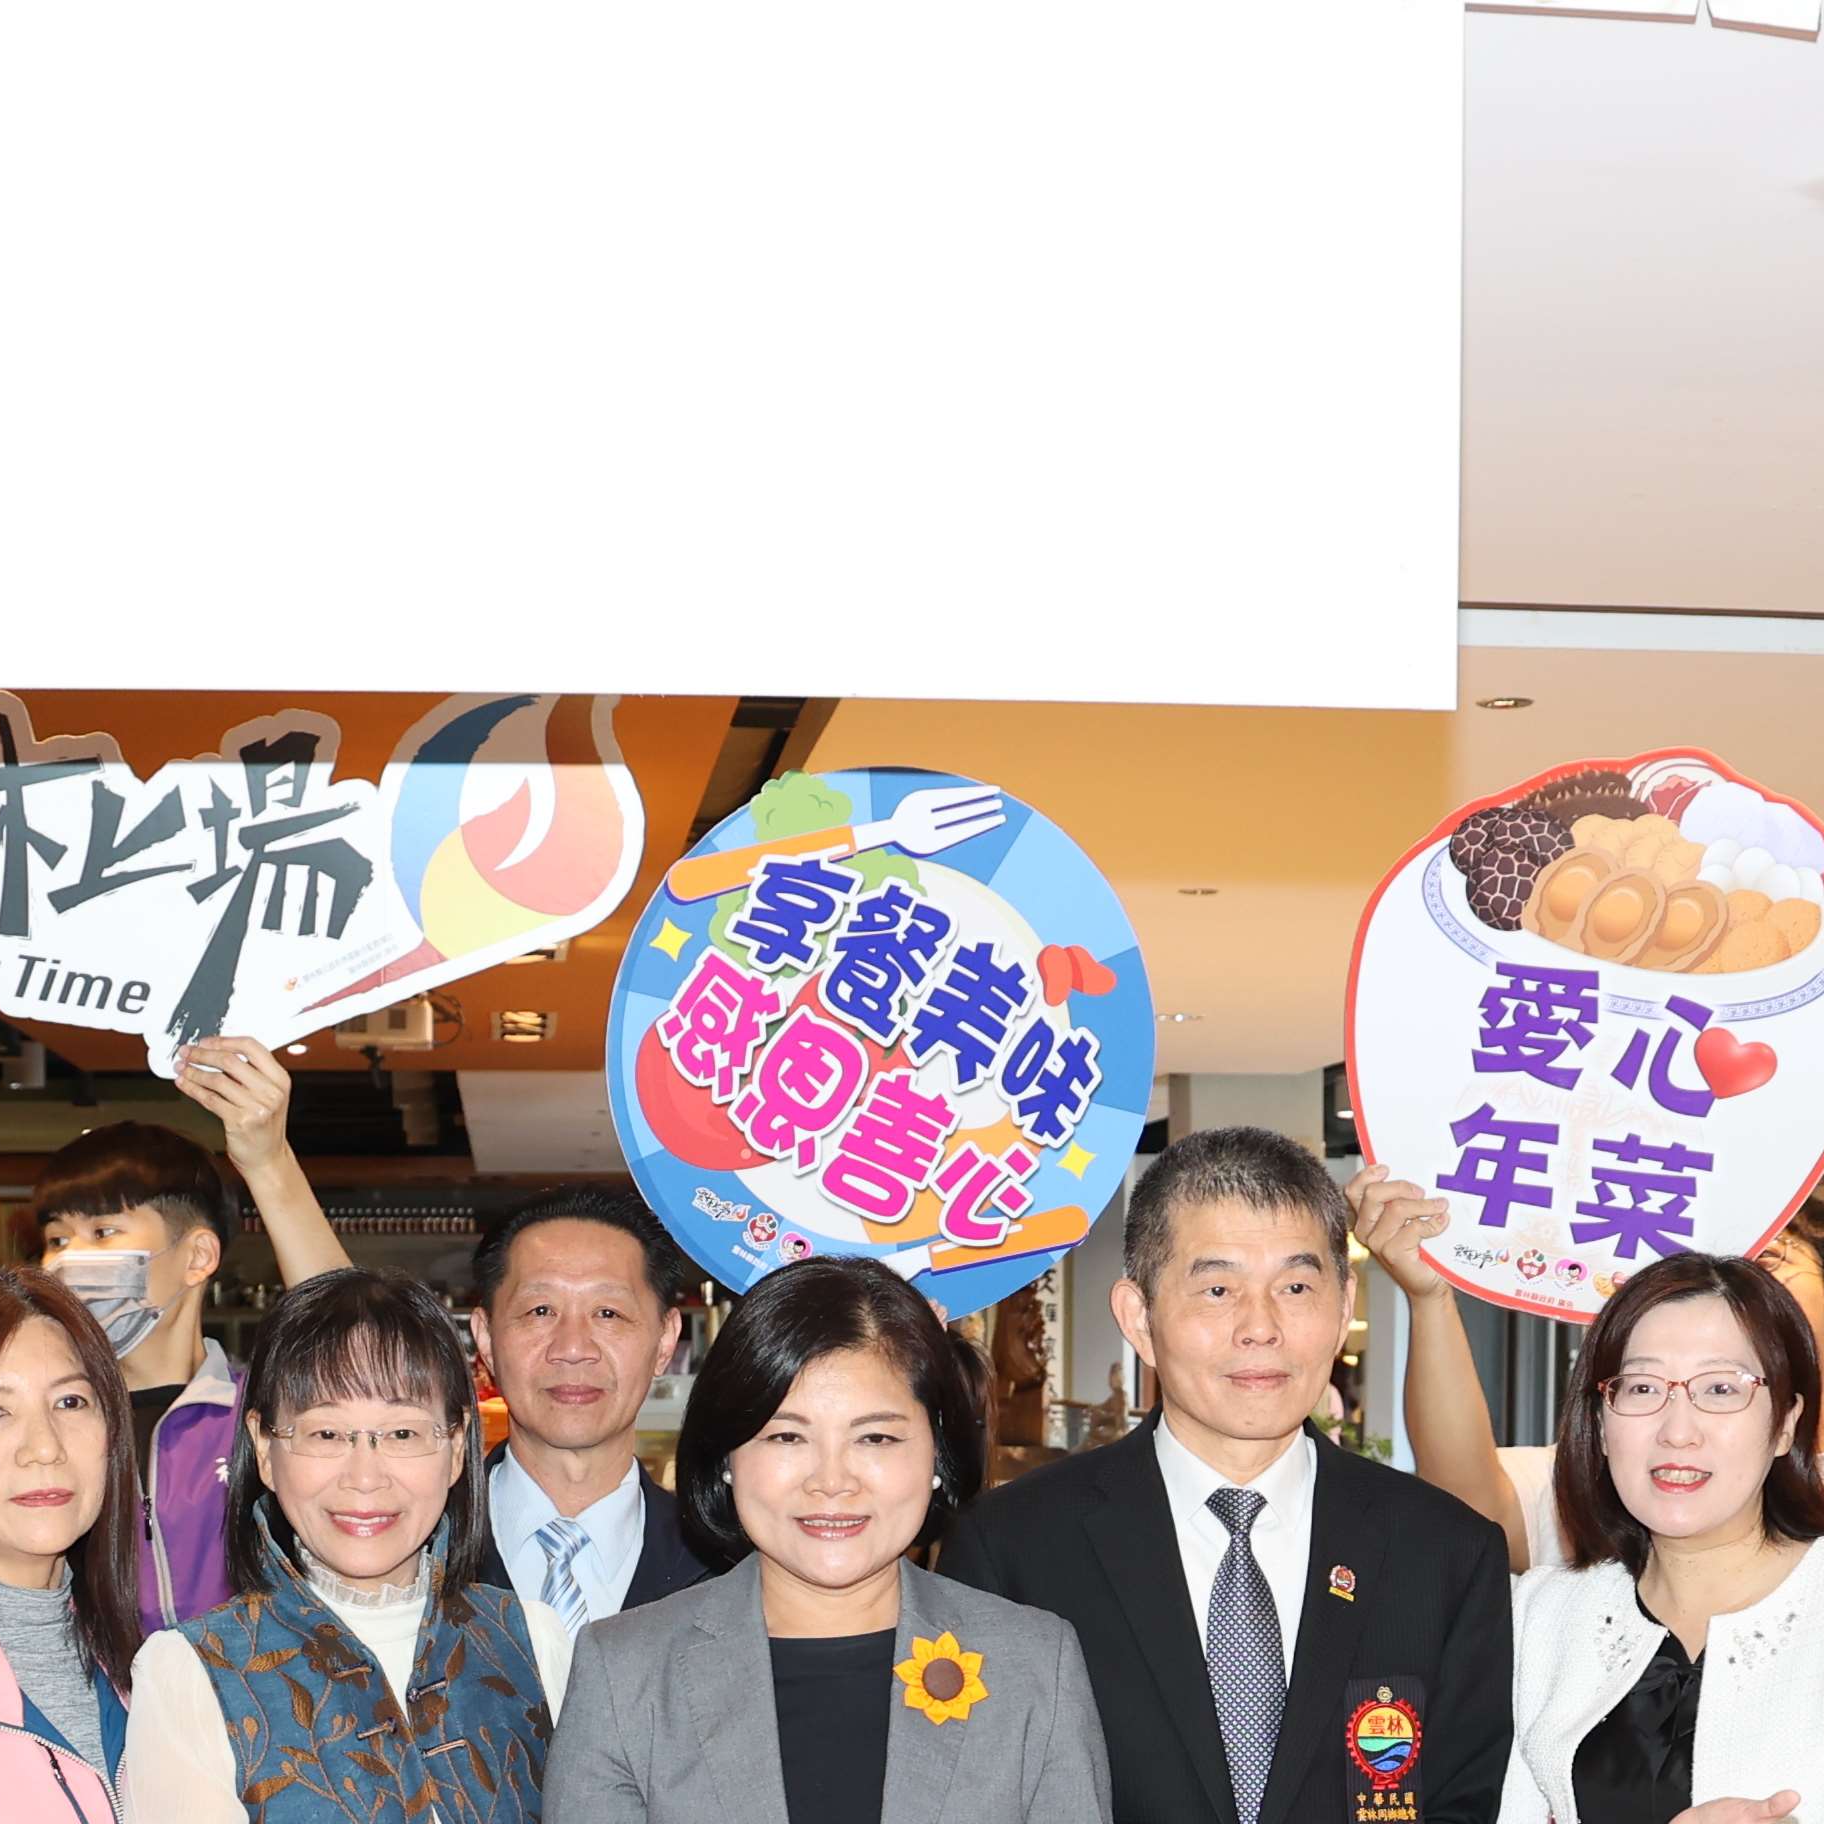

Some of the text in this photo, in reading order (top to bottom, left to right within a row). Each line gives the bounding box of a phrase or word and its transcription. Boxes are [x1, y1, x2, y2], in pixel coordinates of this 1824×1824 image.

[12, 953, 152, 1016] Time
[732, 858, 1093, 1141] 享餐美味
[1471, 961, 1715, 1119] 愛心
[660, 953, 1035, 1243] 感恩善心
[1435, 1101, 1715, 1261] 年菜
[1366, 1714, 1405, 1736] 雲林
